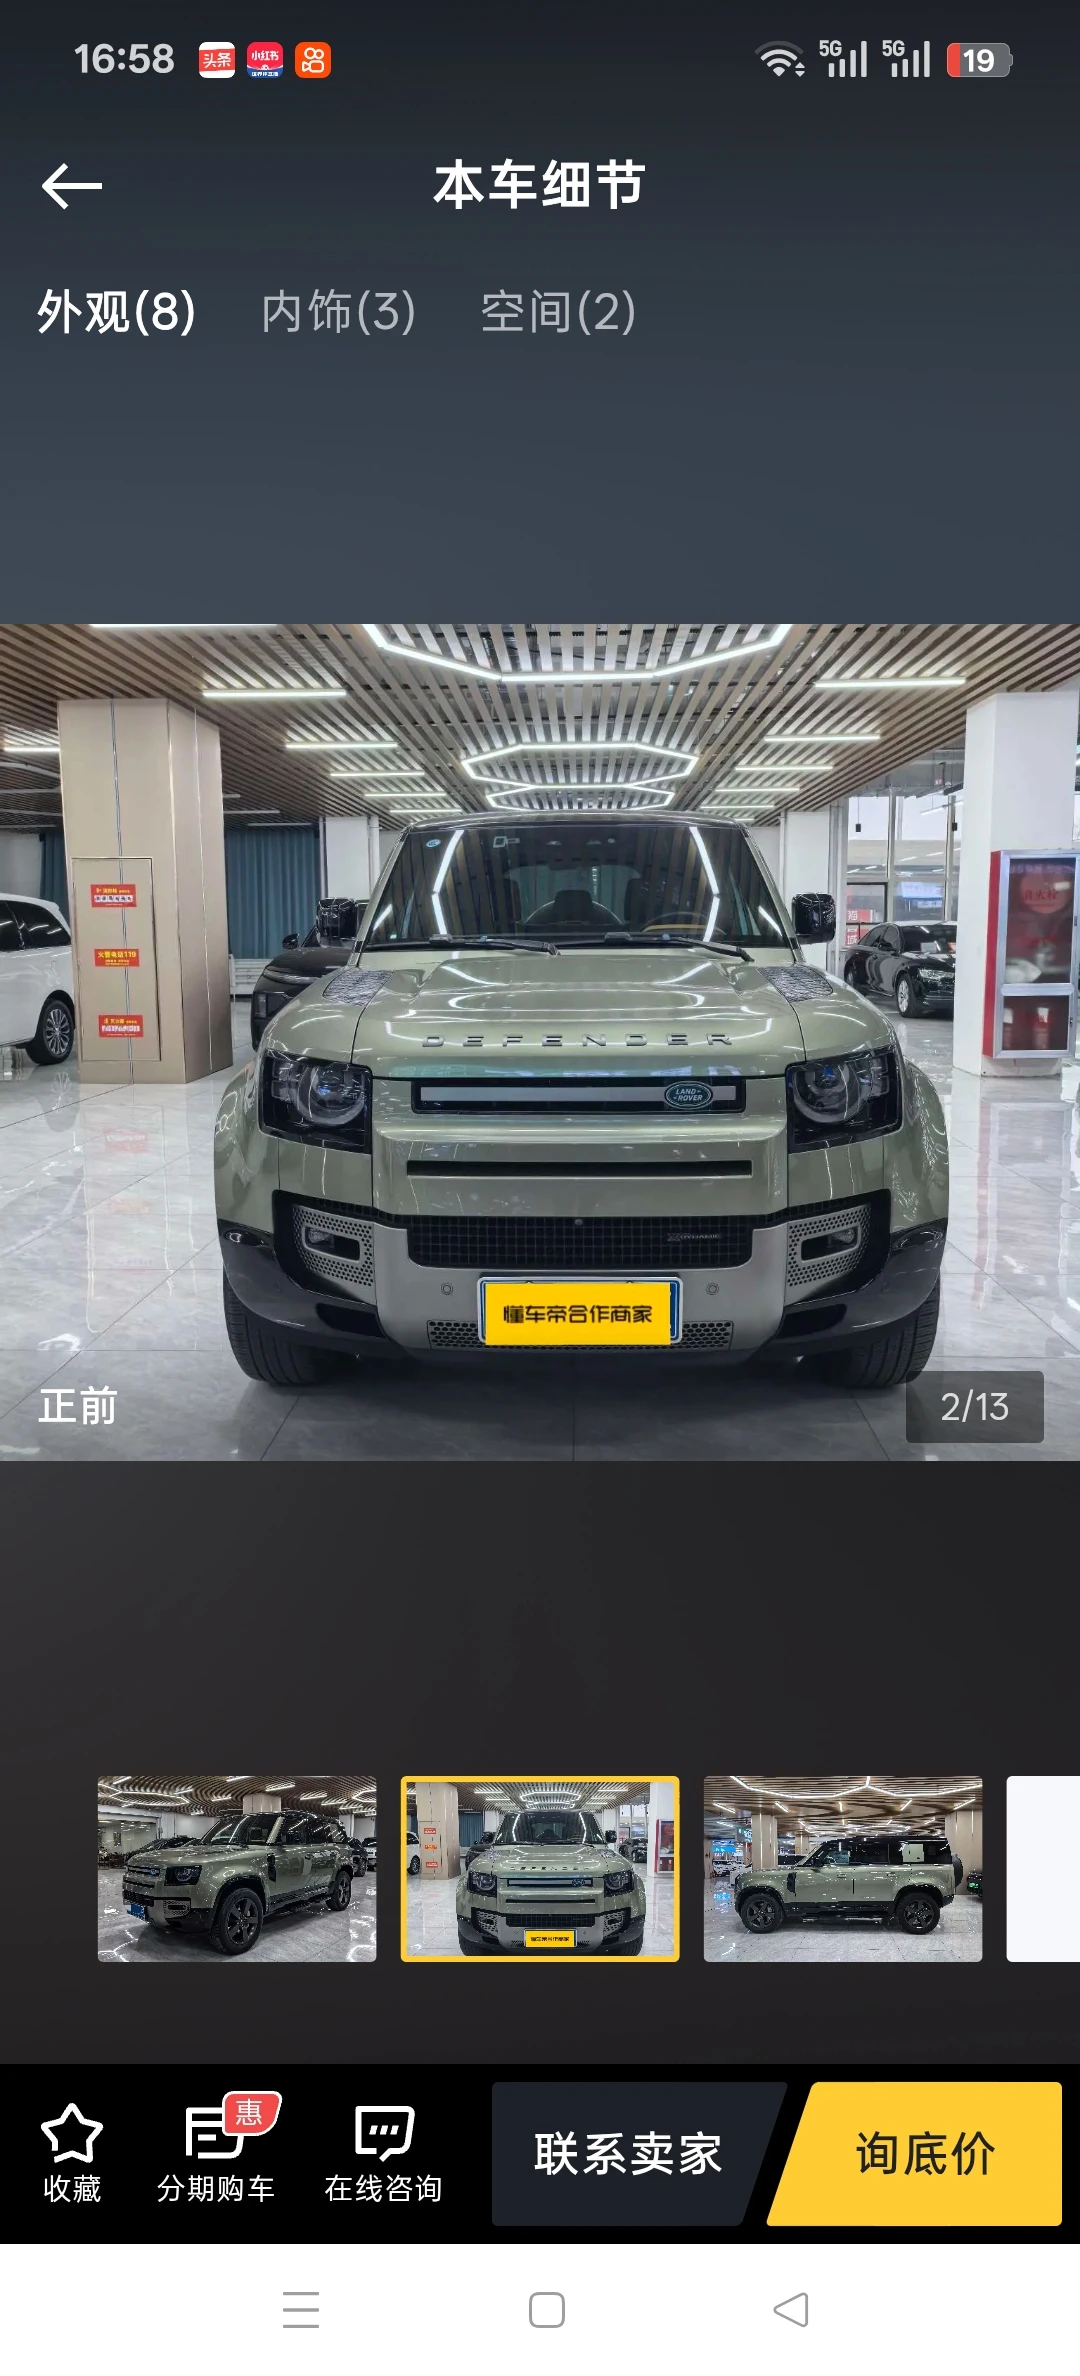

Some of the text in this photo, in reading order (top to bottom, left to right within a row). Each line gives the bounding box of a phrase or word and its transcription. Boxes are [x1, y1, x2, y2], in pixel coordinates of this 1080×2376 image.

[75, 43, 174, 73] 16:58
[203, 52, 232, 69] 头条
[251, 50, 279, 61] 小红书
[820, 40, 842, 56] 5G
[882, 40, 905, 56] 5G
[964, 49, 994, 72] 19
[433, 158, 645, 209] 本车细节
[37, 289, 194, 336] 外观(8)
[264, 289, 414, 335] 内饰(3)
[482, 289, 634, 335] 空间(2)
[422, 1033, 733, 1047] DEFENDER
[38, 1385, 118, 1425] 正前
[941, 1389, 1009, 1422] 2/13
[236, 2099, 263, 2126] 惠
[534, 2131, 723, 2176] 联系卖家
[856, 2131, 996, 2176] 询底价
[43, 2174, 102, 2203] 收藏
[156, 2174, 275, 2203] 分期购车
[324, 2174, 442, 2203] 在线咨询
